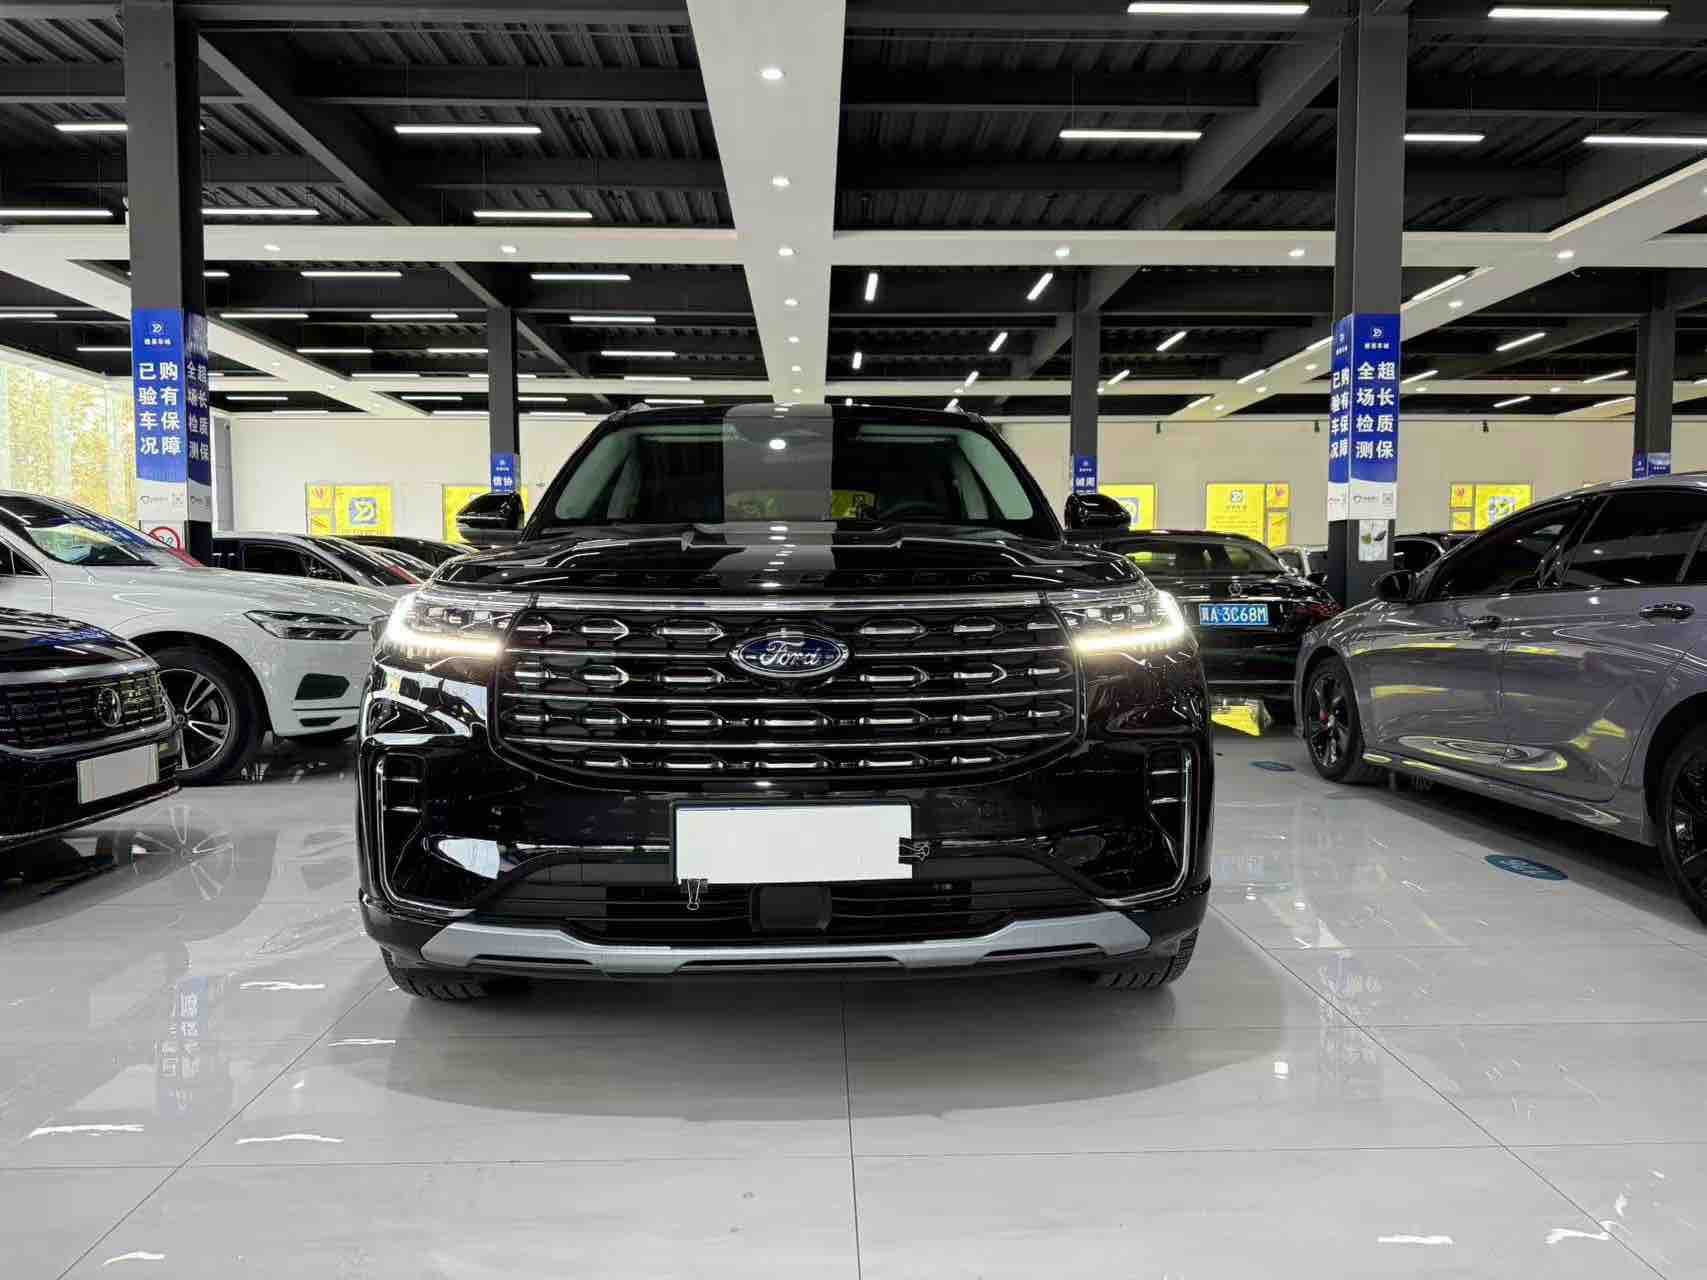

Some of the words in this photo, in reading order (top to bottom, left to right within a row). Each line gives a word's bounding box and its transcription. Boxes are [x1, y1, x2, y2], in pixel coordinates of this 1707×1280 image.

[138, 362, 159, 456] 已验车况
[159, 361, 182, 456] 购有保障
[1355, 361, 1376, 460] 全场检测
[1376, 361, 1396, 460] 超长质保
[758, 639, 820, 666] Ford
